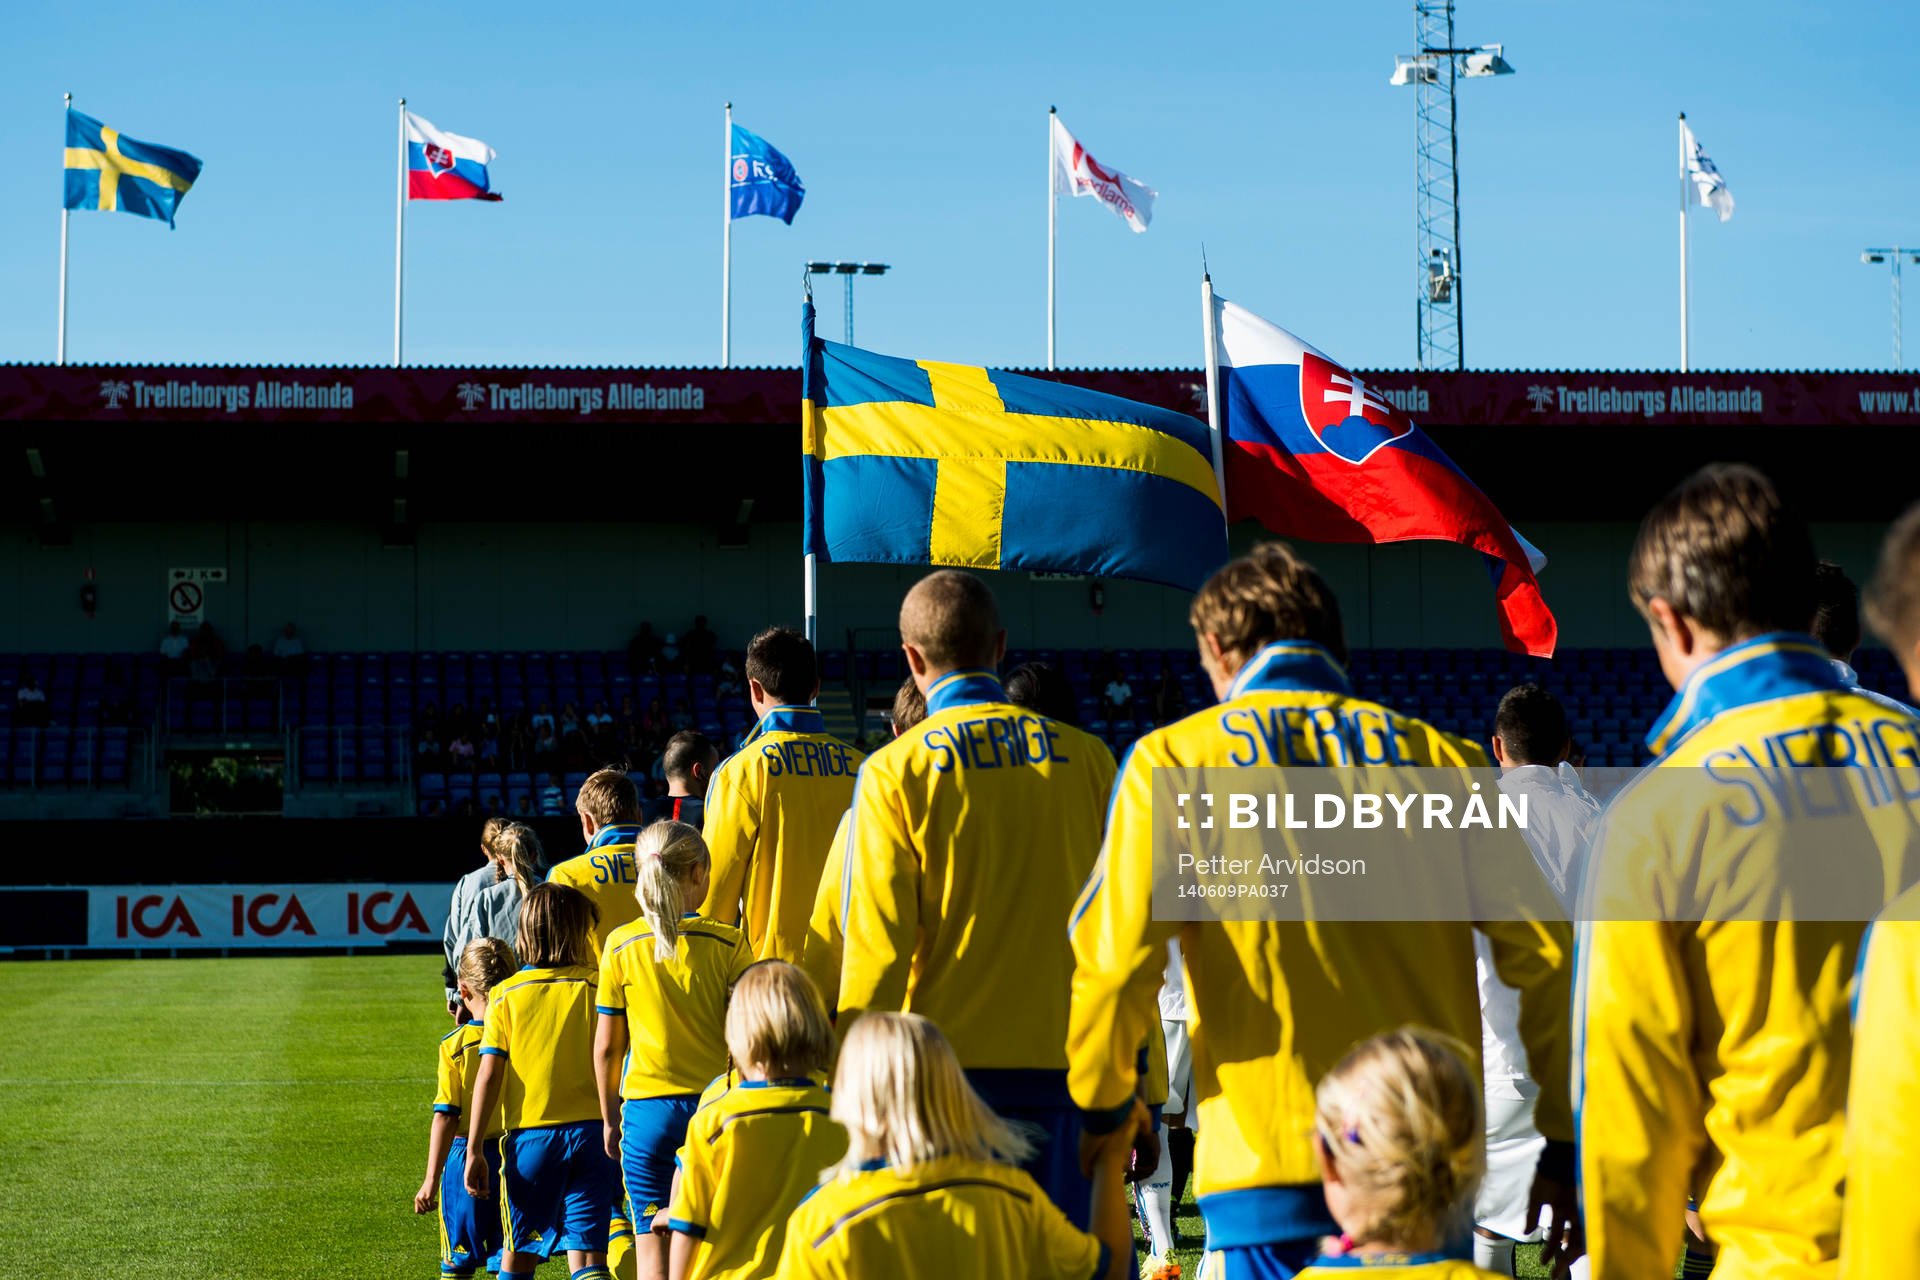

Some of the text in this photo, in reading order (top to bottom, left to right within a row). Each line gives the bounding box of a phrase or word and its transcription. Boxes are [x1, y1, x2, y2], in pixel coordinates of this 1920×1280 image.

[133, 381, 353, 413] Trelleborgs Allehanda
[489, 383, 704, 415] Trelleborgs Allehanda
[1557, 386, 1762, 417] Trelleborgs Allehanda
[117, 891, 431, 939] ICA ICA ICA
